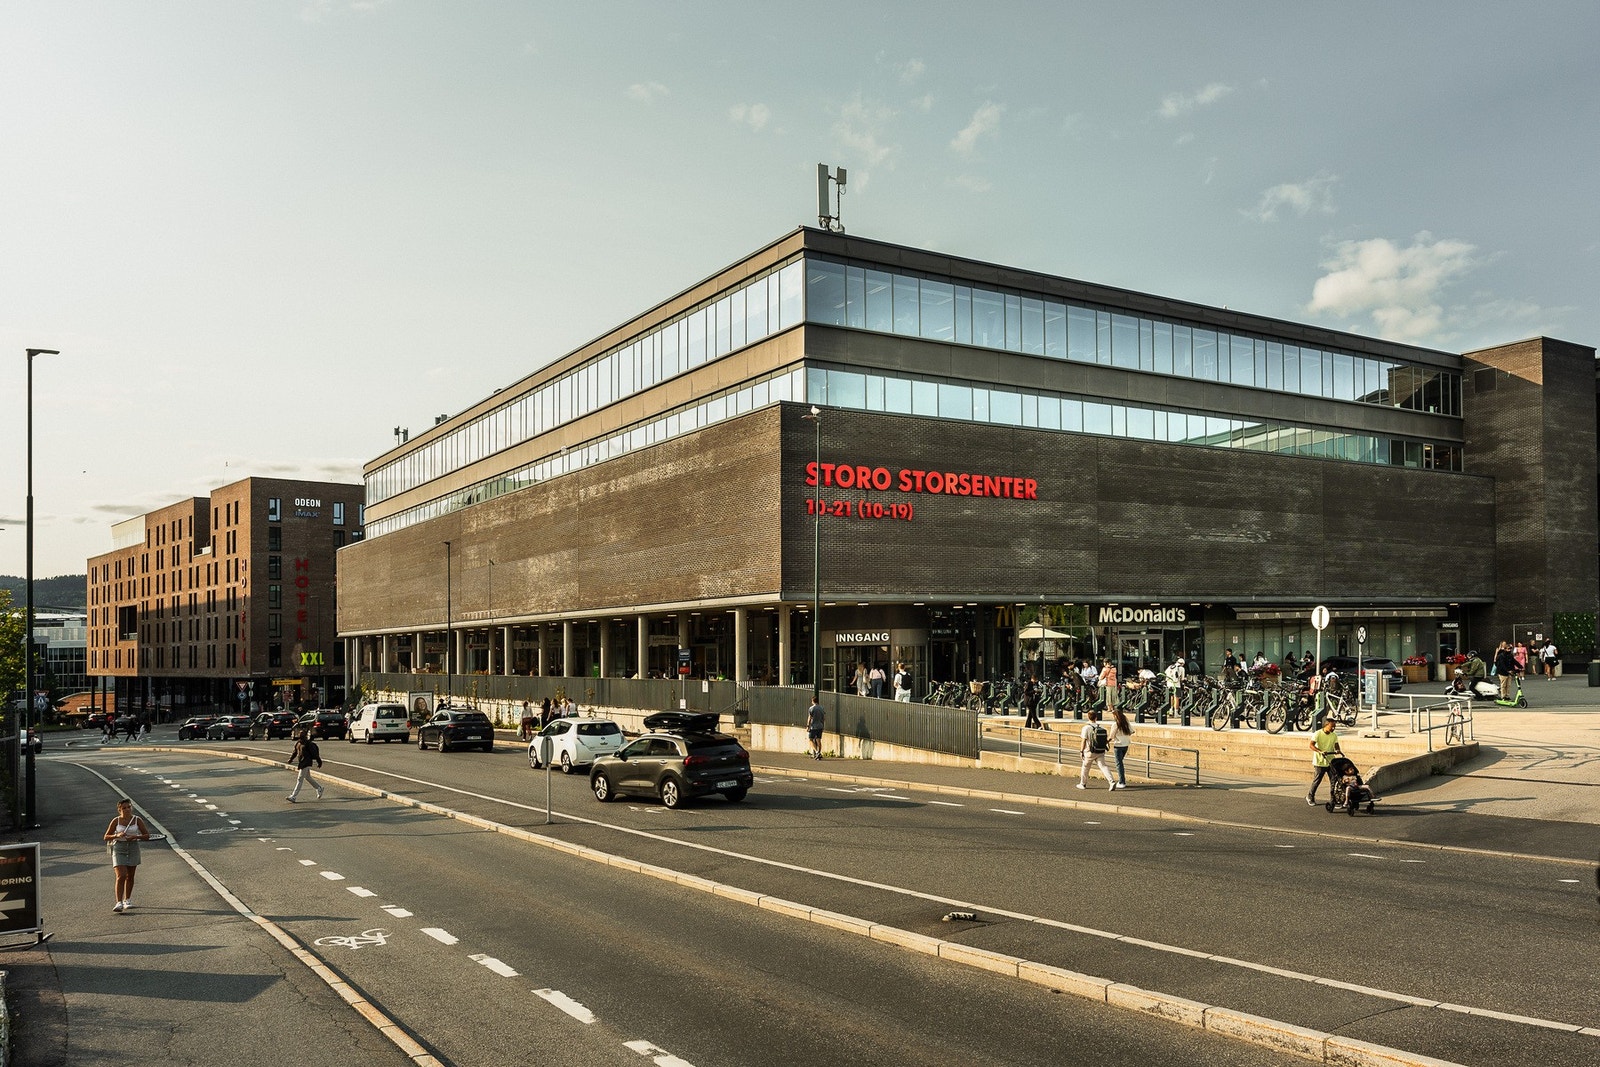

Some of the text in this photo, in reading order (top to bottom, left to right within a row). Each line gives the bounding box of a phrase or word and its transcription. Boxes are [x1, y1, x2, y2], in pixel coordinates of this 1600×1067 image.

[805, 461, 1038, 499] STORO STORSENTER
[294, 498, 321, 507] ODEON
[805, 499, 914, 521] 10-21 (10-19)
[295, 557, 309, 640] HOTEL
[1098, 607, 1186, 622] McDonald's
[835, 632, 890, 643] INNGANG
[300, 652, 324, 666] XXL
[0, 875, 33, 886] ØRING
